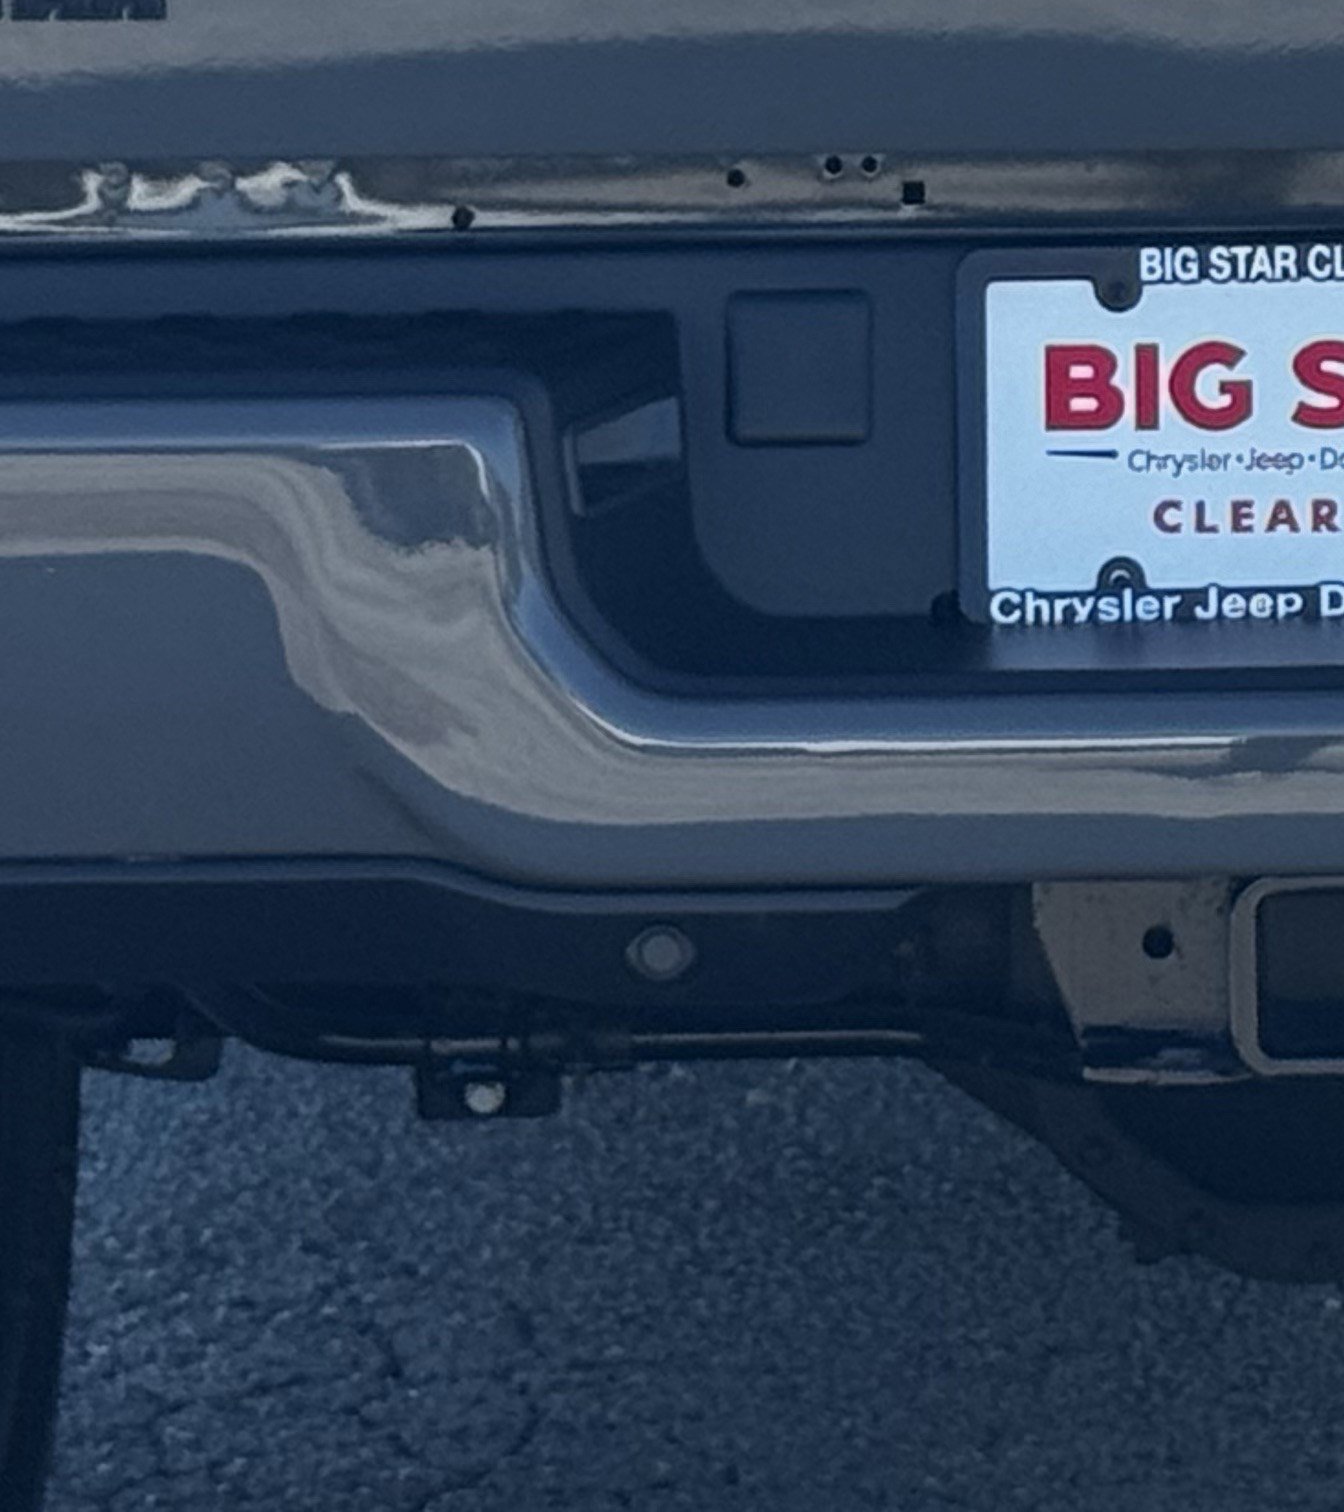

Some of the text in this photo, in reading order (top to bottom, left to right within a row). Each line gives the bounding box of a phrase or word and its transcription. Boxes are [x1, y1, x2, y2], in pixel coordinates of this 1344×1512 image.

[1140, 246, 1199, 281] BIG
[1208, 245, 1298, 280] STAR
[1044, 340, 1254, 431] BIG
[1127, 447, 1231, 478] Chrysler
[1245, 446, 1304, 475] Jeep
[1152, 498, 1341, 534] CLEAR
[990, 587, 1182, 626] Chrysler
[1194, 586, 1303, 621] Jeep
